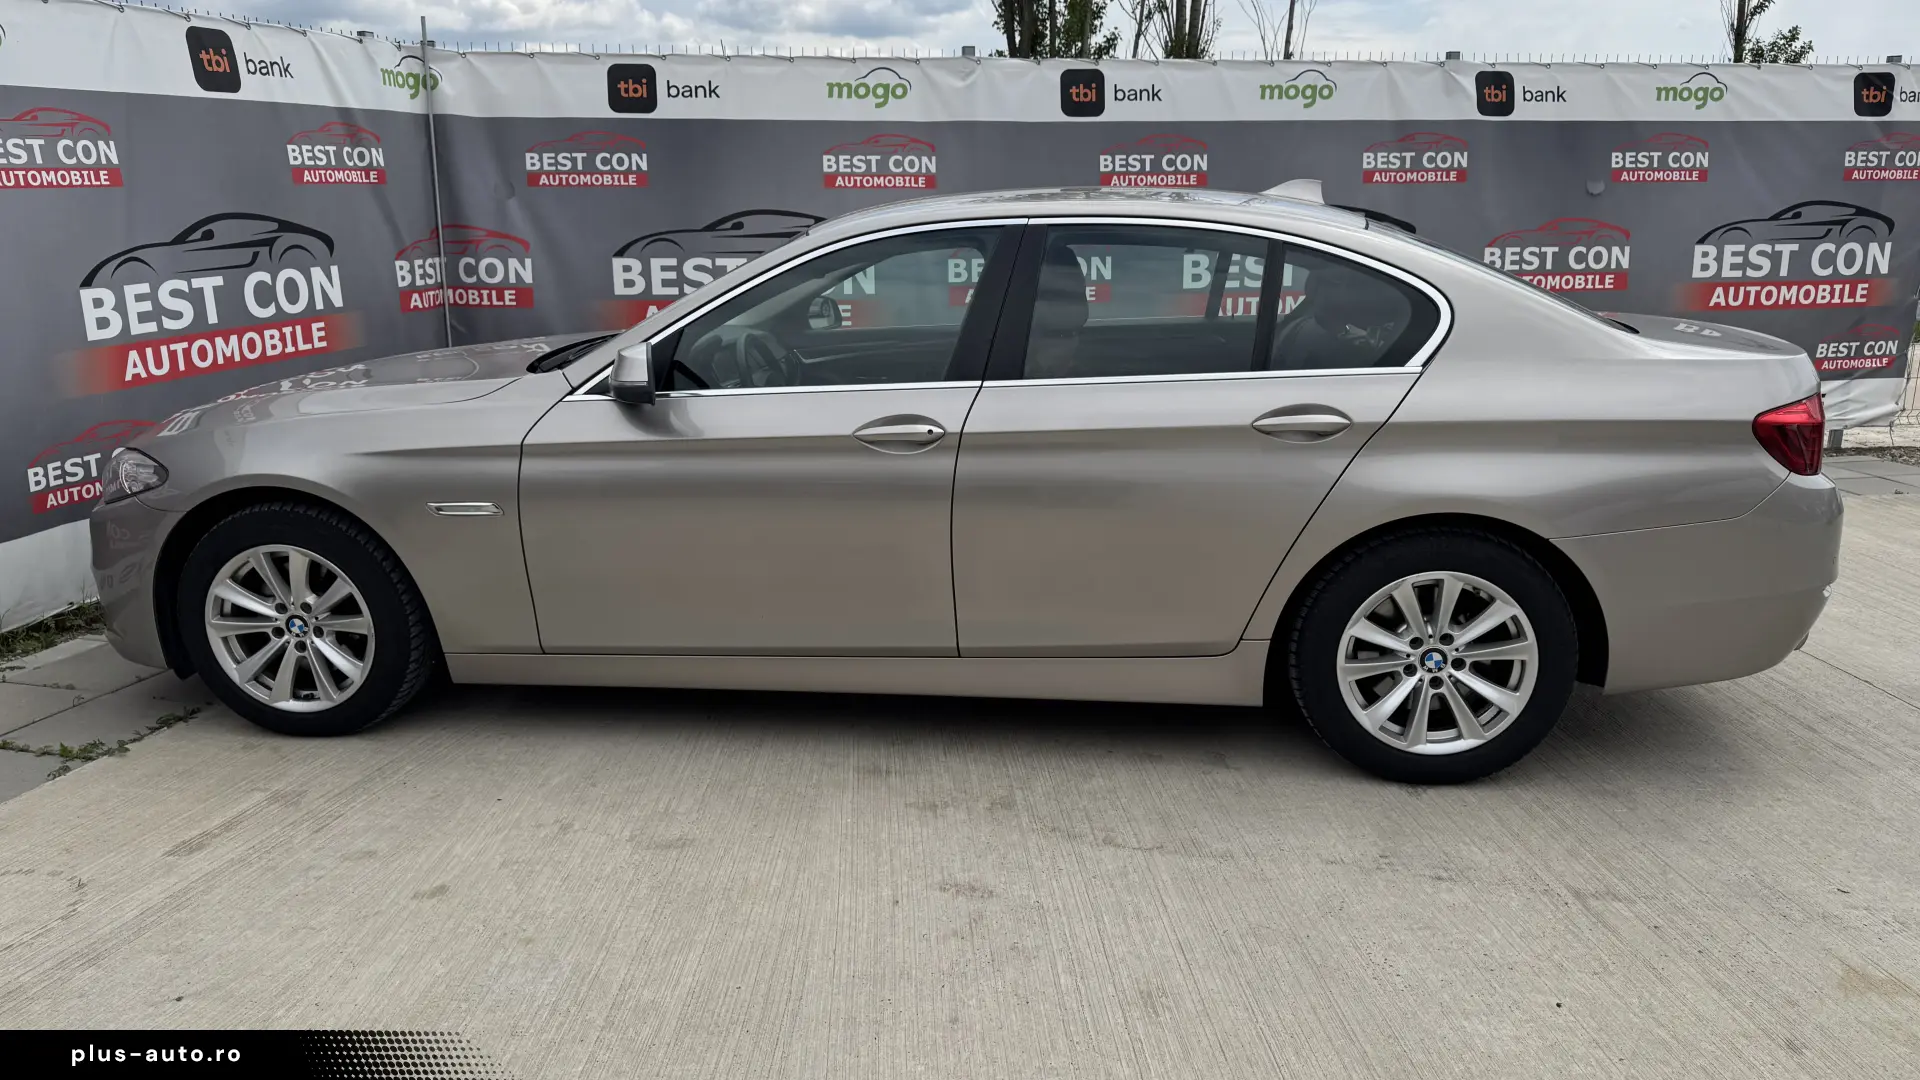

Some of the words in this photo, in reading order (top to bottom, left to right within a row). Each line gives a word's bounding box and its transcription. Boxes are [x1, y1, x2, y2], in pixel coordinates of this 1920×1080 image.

[200, 48, 231, 73] tbi
[244, 53, 294, 79] bank
[380, 67, 439, 100] mogo
[617, 79, 647, 98] tbi
[666, 80, 720, 99] bank
[1069, 83, 1096, 102] tbi
[1113, 84, 1163, 102] bank
[826, 79, 909, 109] mogo
[1259, 82, 1334, 109] mogo
[1484, 84, 1507, 102] tbi
[1522, 85, 1567, 103] bank
[1656, 82, 1725, 110] mogo
[1861, 86, 1887, 103] tbi
[0, 138, 45, 165] EST
[56, 139, 119, 165] CON
[287, 144, 337, 166] BEST
[343, 147, 385, 167] CON
[1362, 152, 1416, 169] BEST
[1421, 151, 1468, 168] CON
[1611, 152, 1662, 168] BEST
[1668, 151, 1709, 168] CON
[1844, 151, 1890, 167] BEST
[1895, 150, 1920, 167] CO
[525, 152, 587, 171] BEST
[595, 152, 648, 171] CON
[822, 155, 880, 173] BEST
[888, 155, 936, 173] CON
[1099, 154, 1154, 172] BEST
[1161, 154, 1208, 172] CON
[0, 170, 110, 187] UTOMOBILE
[303, 170, 379, 184] AUTOMOBILE
[538, 174, 637, 187] AUTOMOBILE
[835, 175, 926, 188] AUTOMOBILE
[1110, 174, 1197, 187] AUTOMOBILE
[1373, 170, 1457, 183] AUTOMOBILE
[1620, 170, 1699, 181] AUTOMOBILE
[1852, 169, 1919, 180] AUTOMOBILE
[1483, 246, 1559, 271] BEST
[1568, 245, 1631, 270] CON
[1691, 243, 1799, 279] BEST
[1810, 241, 1893, 278] CON
[394, 256, 446, 288] BEST
[458, 257, 534, 284] CON
[79, 275, 224, 342] BEST
[243, 265, 344, 319] CON
[1708, 283, 1870, 308] AUTOMOBILE
[124, 322, 328, 382] AUTOMOBILE
[1815, 341, 1860, 358] BEST
[1863, 340, 1899, 356] CON
[1821, 358, 1889, 370] AUTOMOBILE
[27, 452, 101, 493] BEST
